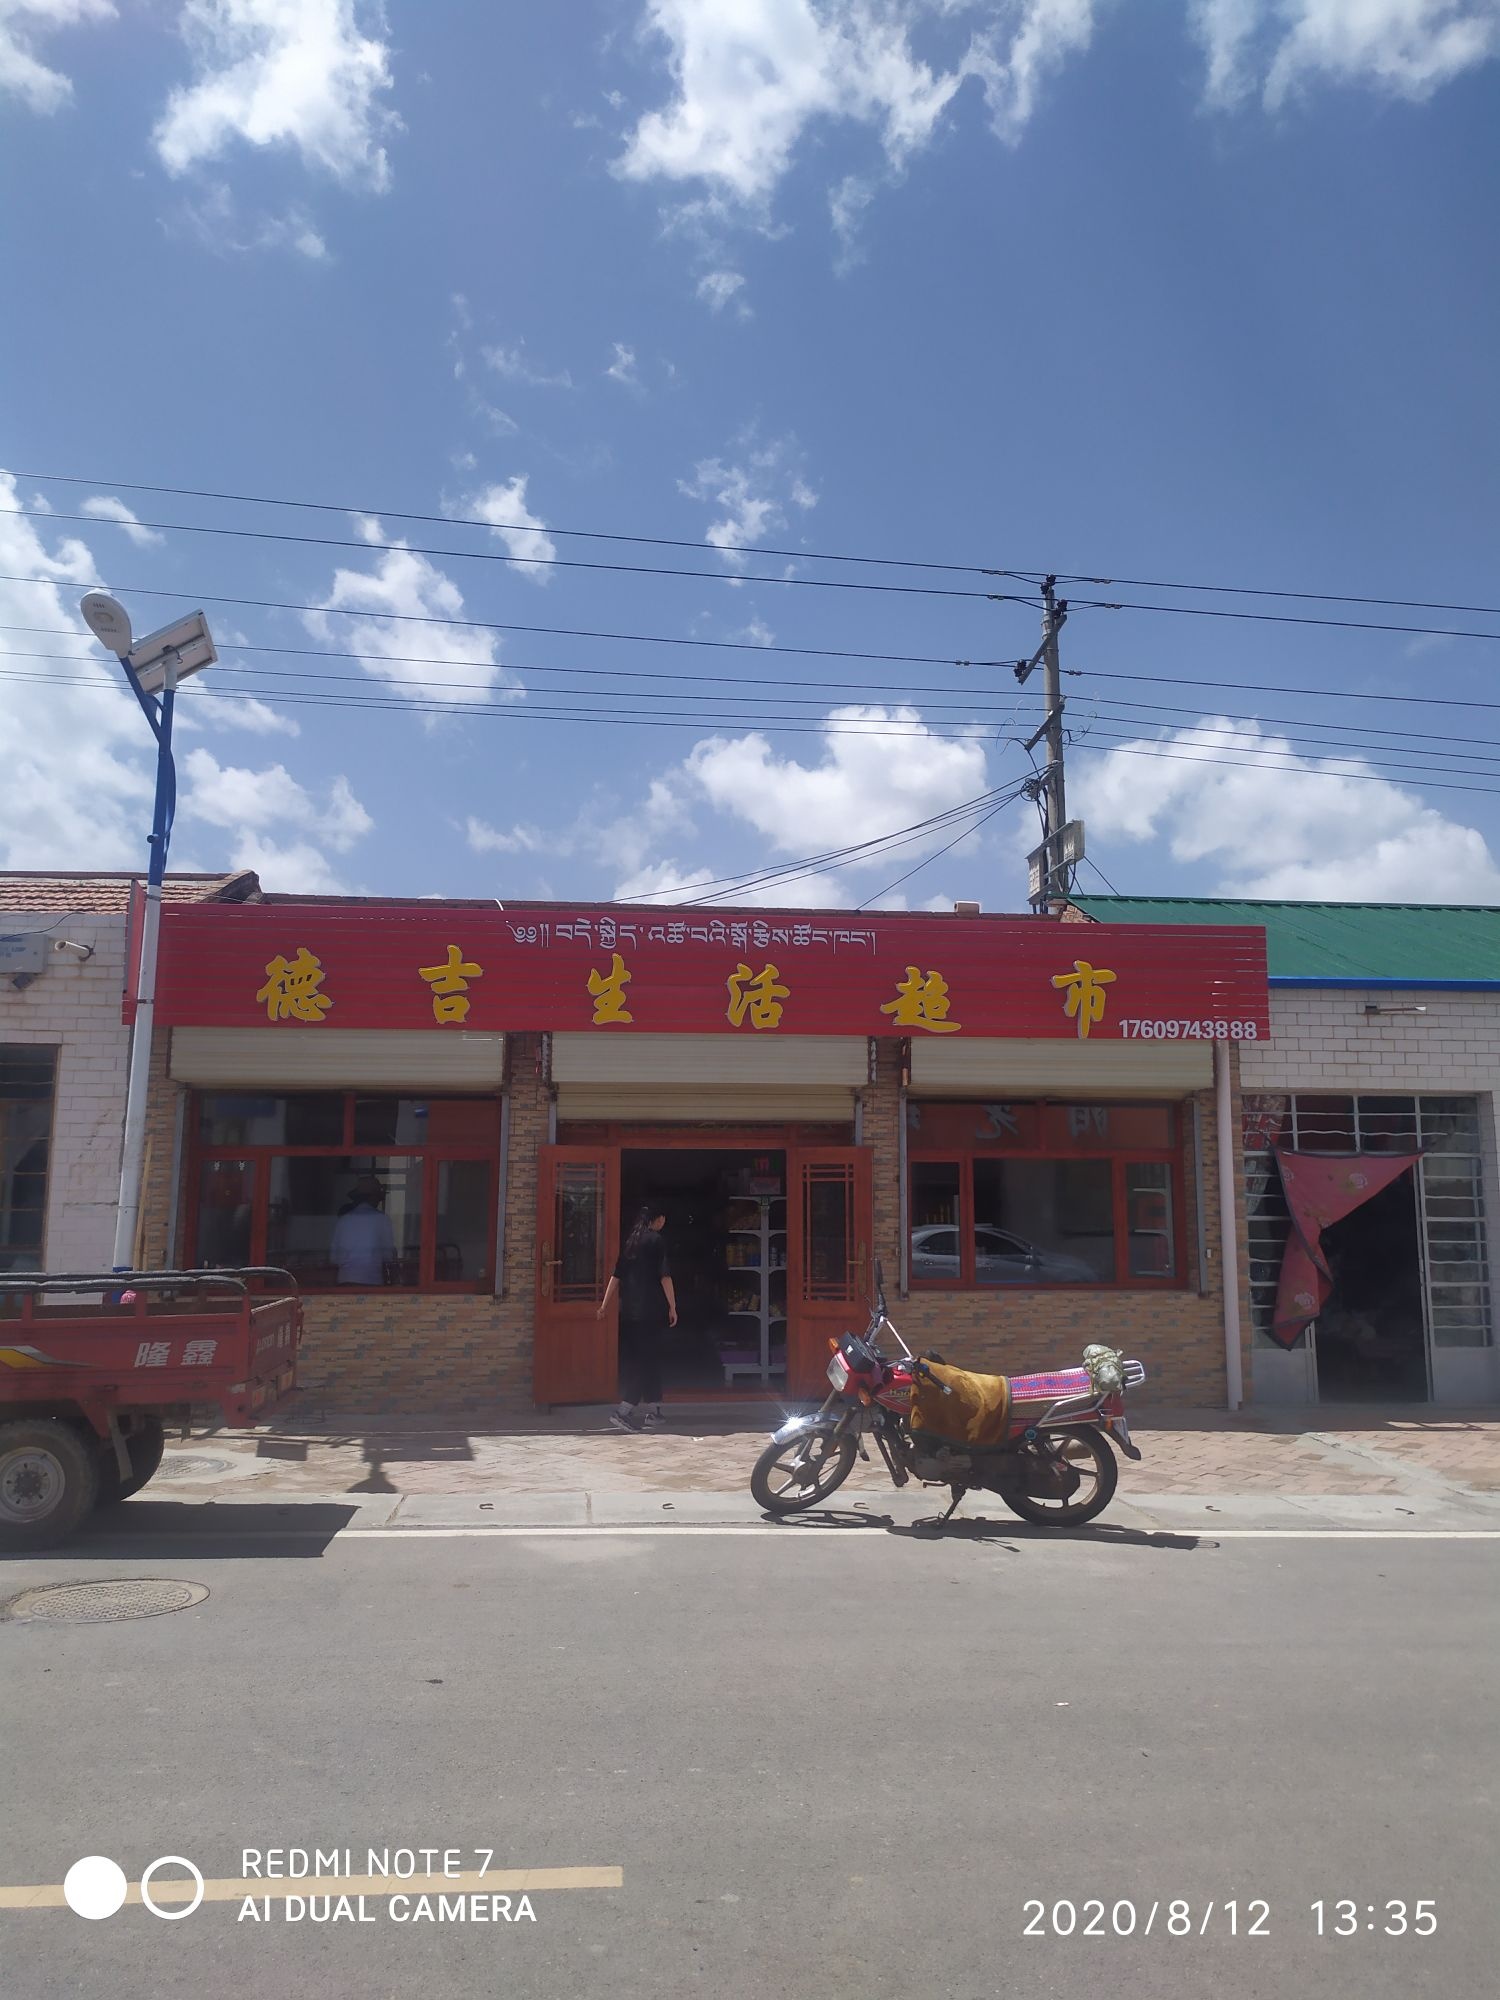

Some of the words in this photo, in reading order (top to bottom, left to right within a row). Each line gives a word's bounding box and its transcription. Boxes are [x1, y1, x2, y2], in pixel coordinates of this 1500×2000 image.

[256, 944, 1117, 1040] 德吉生活超市
[1119, 1019, 1258, 1040] 17609743888
[134, 1340, 218, 1367] 隆鑫
